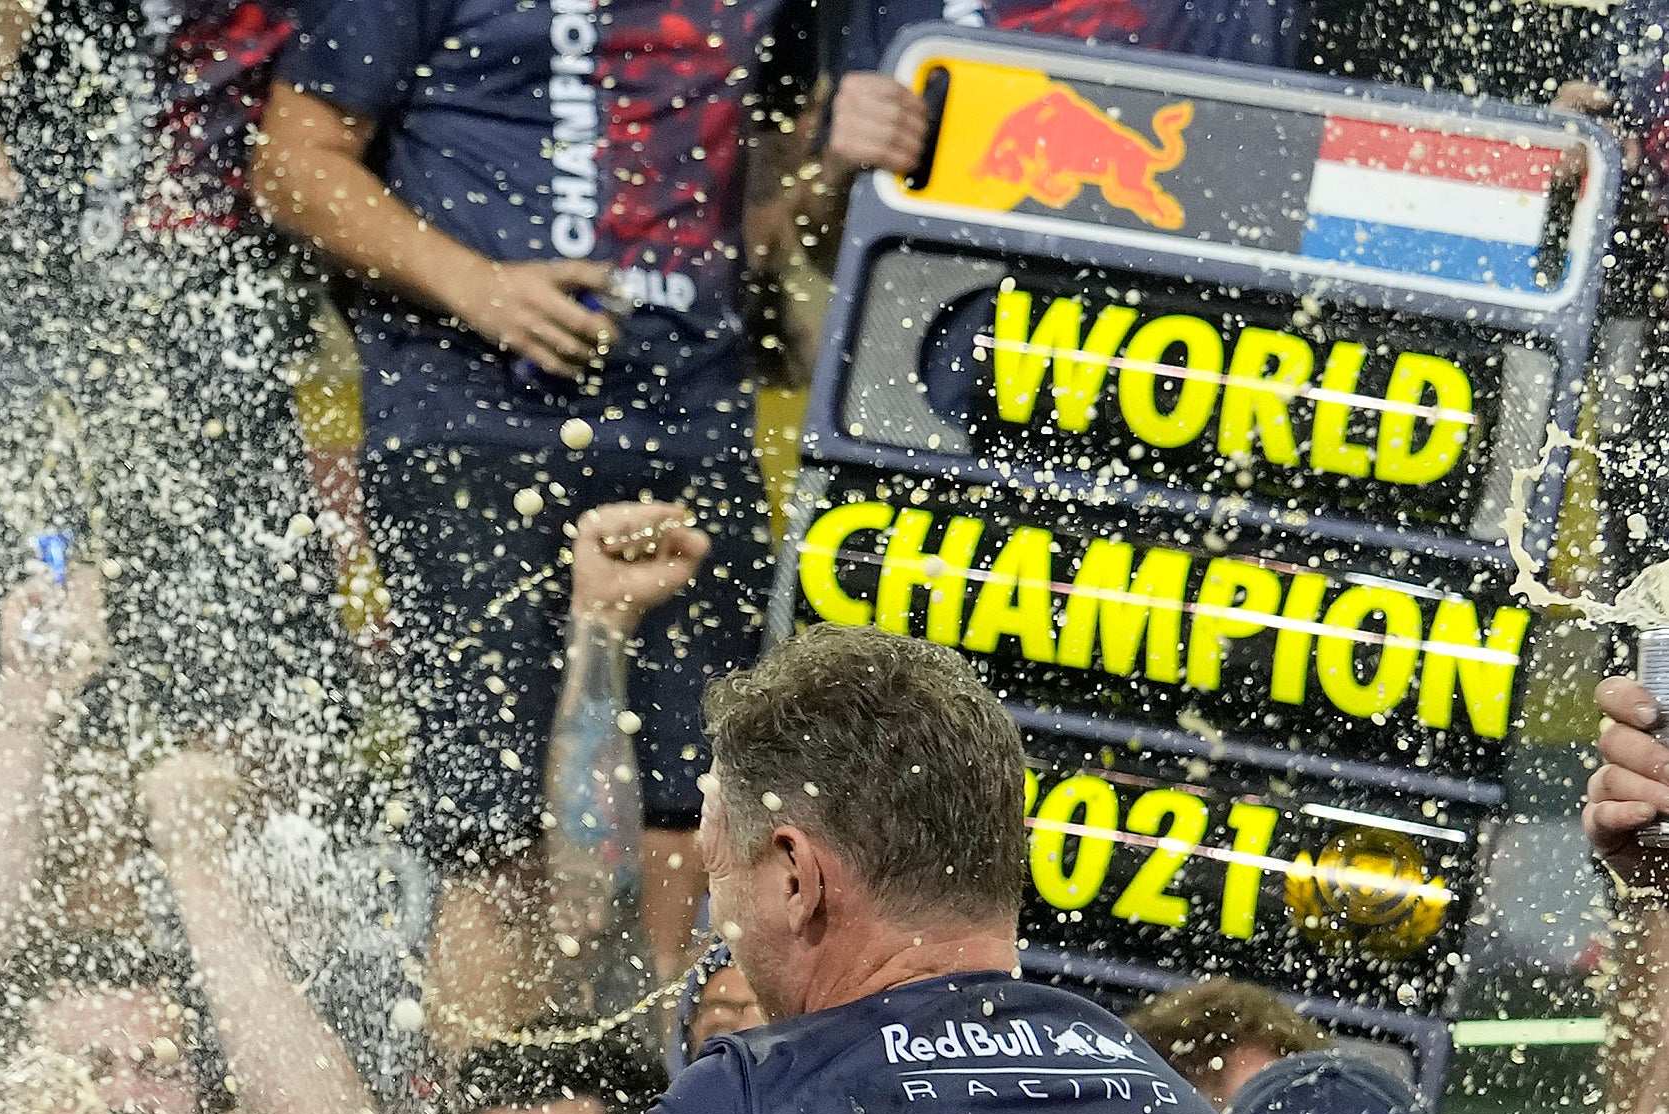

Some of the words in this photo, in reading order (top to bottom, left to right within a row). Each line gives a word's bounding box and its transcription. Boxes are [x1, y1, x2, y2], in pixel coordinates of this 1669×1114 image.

[993, 291, 1473, 484] WORLD
[799, 502, 1530, 740] CHAMPION
[1024, 768, 1279, 940] 021
[902, 1078, 1179, 1105] RACING
